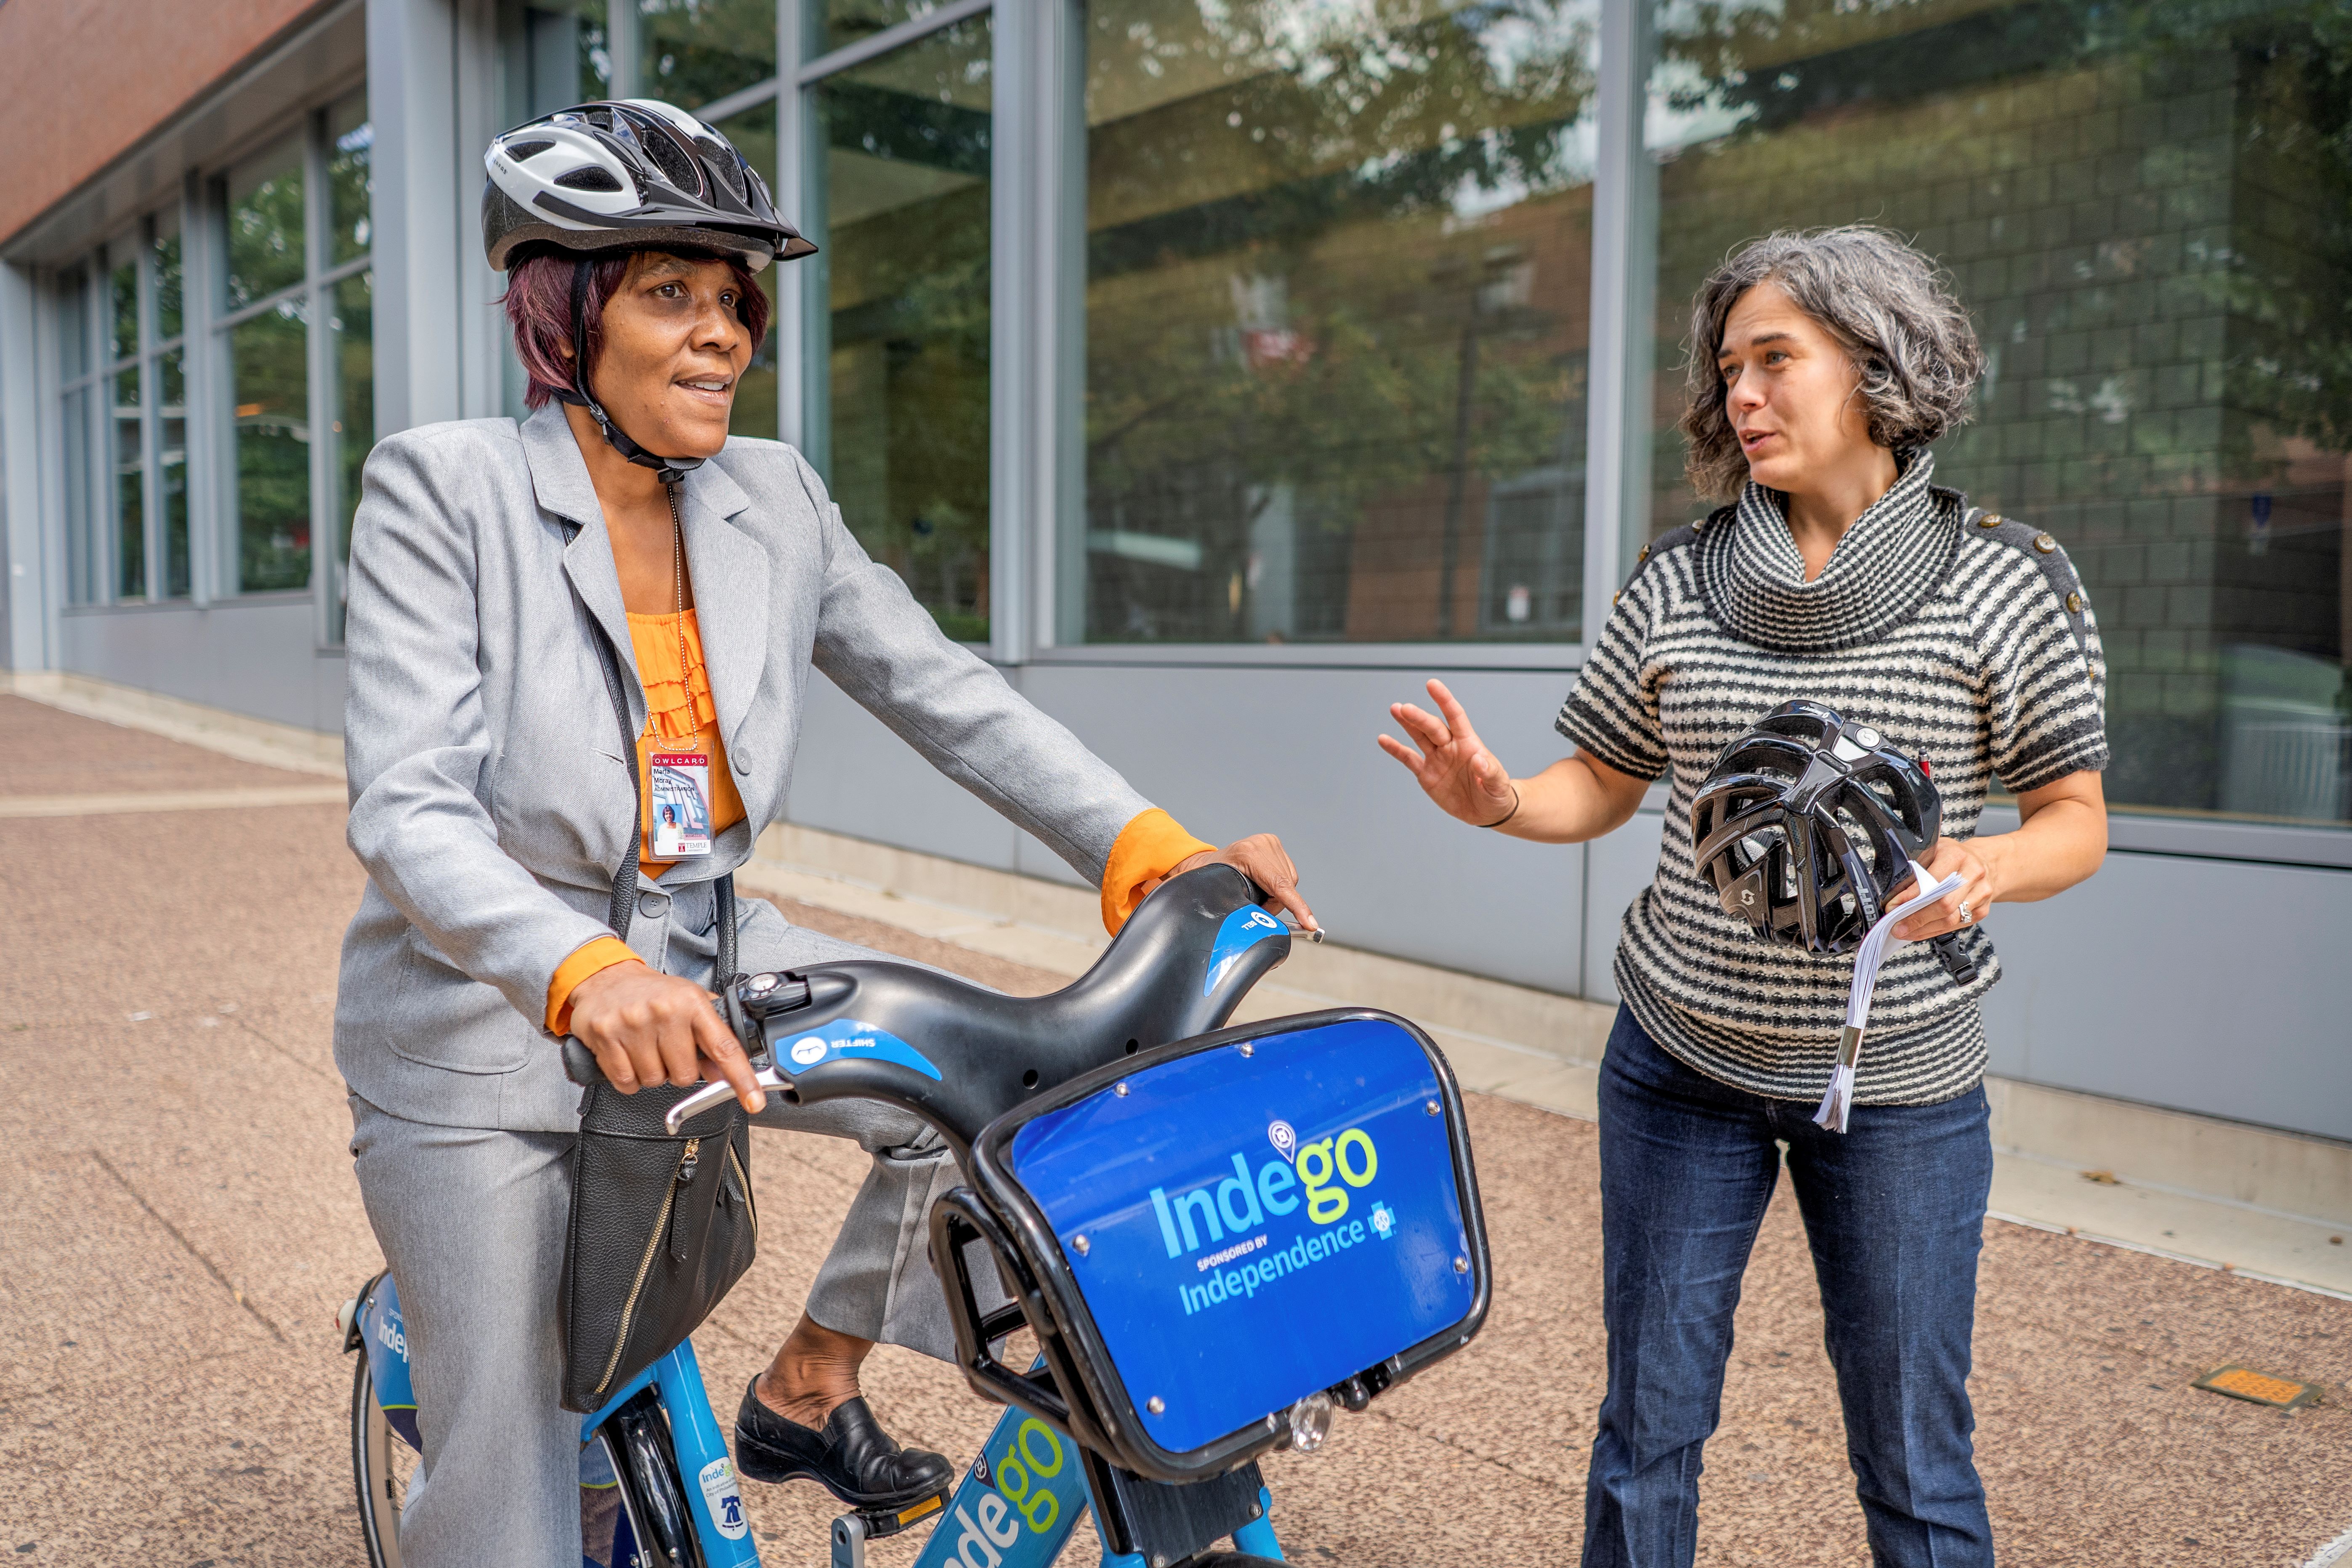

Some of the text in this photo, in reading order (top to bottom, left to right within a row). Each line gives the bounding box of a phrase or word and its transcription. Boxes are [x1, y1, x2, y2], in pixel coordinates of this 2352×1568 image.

[1241, 920, 1257, 930] BELL
[830, 1039, 876, 1048] SHIFTER
[1150, 1128, 1378, 1260] Indego
[1179, 1220, 1366, 1316] Independence
[1197, 1233, 1268, 1272] SPONSORED BY
[943, 1417, 1063, 1568] dego
